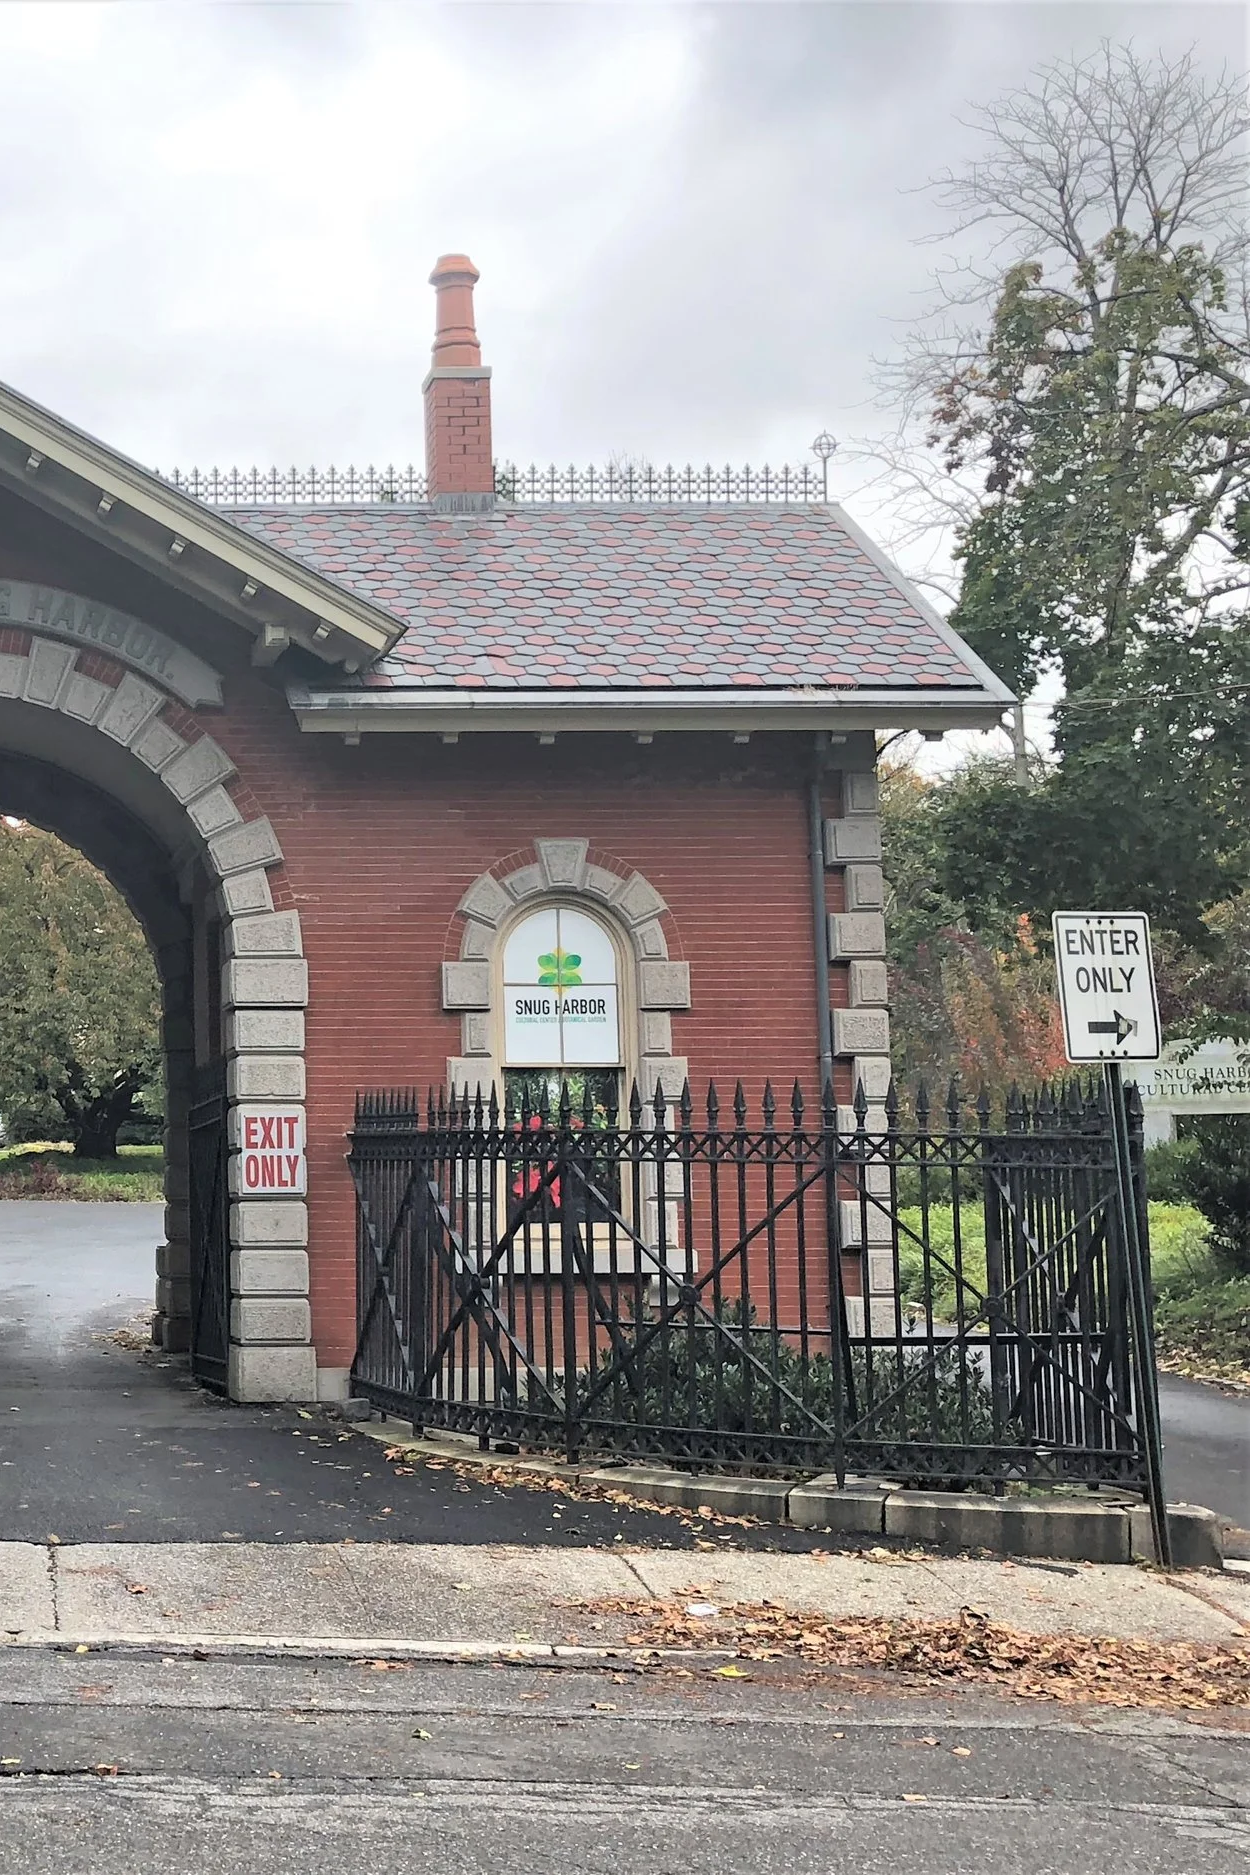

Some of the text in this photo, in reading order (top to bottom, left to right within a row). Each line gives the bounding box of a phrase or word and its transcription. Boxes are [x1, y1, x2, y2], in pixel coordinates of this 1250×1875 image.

[1065, 929, 1140, 956] ENTER
[1076, 966, 1135, 993] ONLY
[515, 999, 550, 1015] SNUG
[1154, 1066, 1250, 1080] SNUG HARB
[244, 1116, 299, 1149] EXIT
[245, 1154, 300, 1188] ONLY
